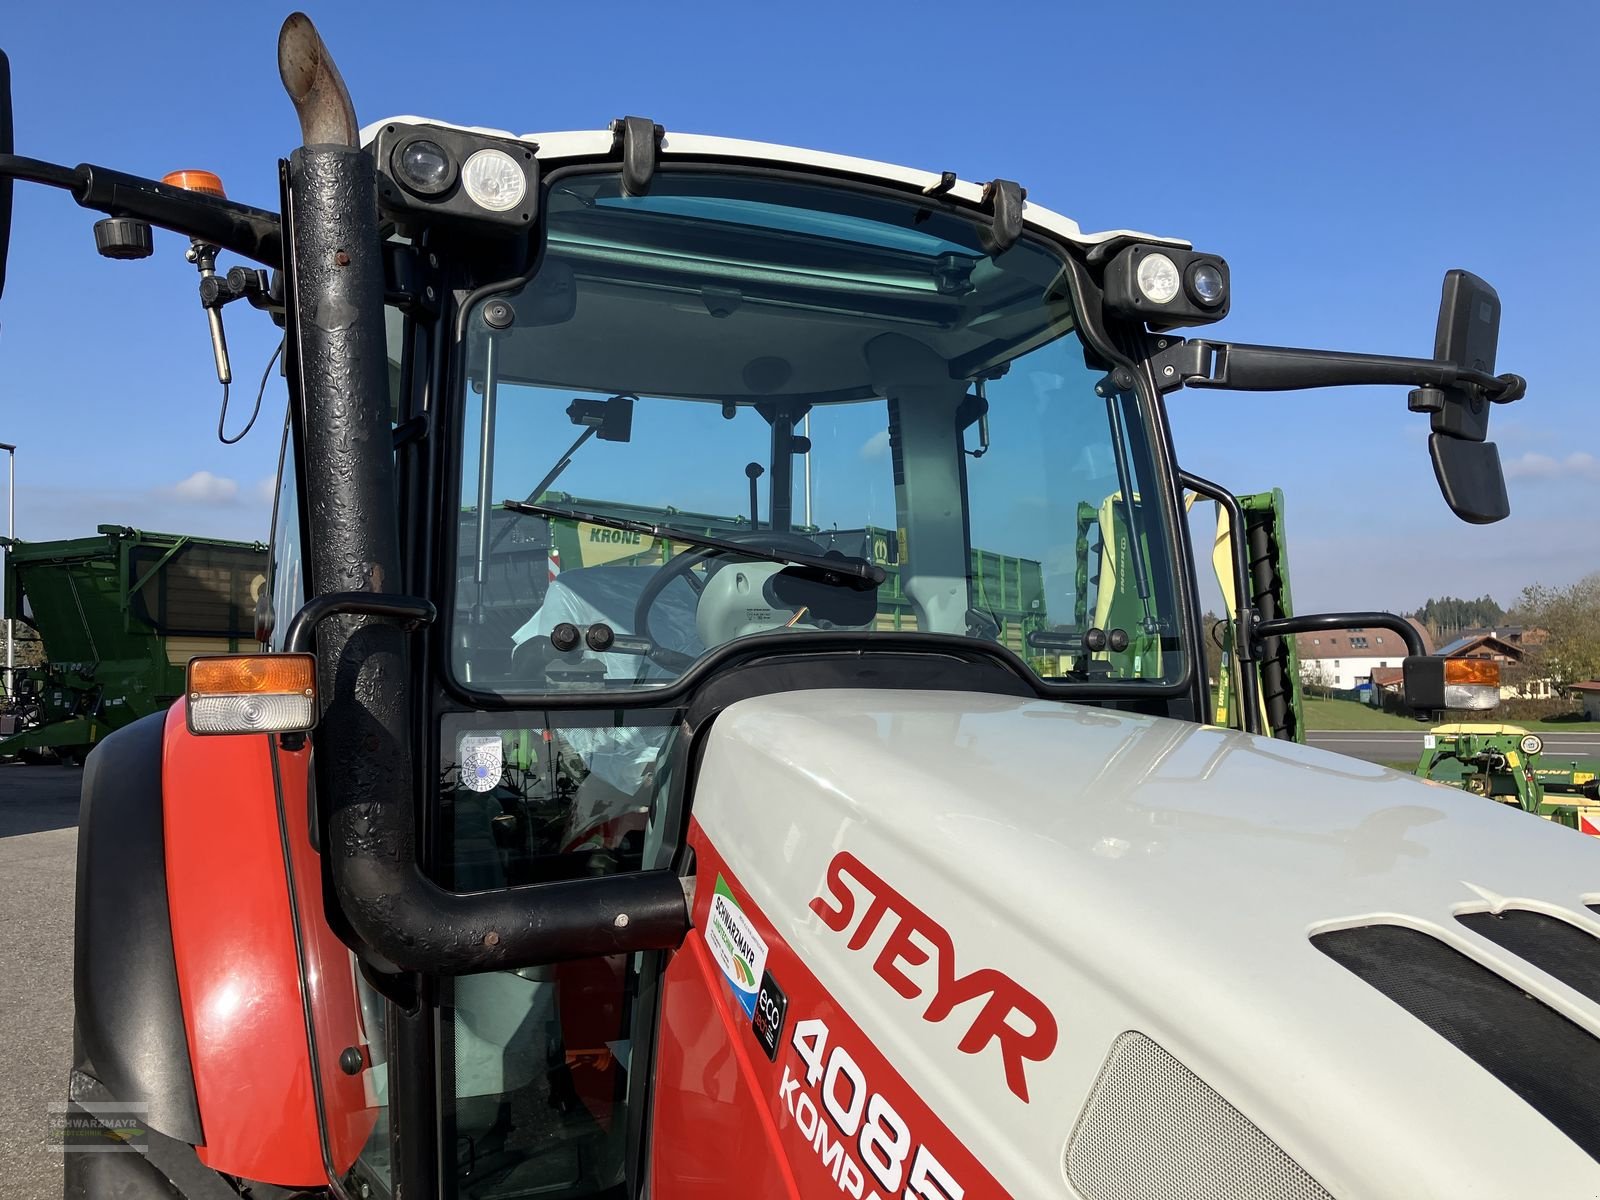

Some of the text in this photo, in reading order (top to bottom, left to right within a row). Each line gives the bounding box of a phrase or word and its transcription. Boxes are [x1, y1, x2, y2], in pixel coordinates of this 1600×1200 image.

[590, 528, 641, 545] KRONE
[715, 896, 755, 967] SCHWARZMAYR
[808, 850, 1058, 1104] STEYR
[755, 1012, 768, 1038] tech
[759, 989, 780, 1030] eco
[779, 1065, 882, 1200] KOMP
